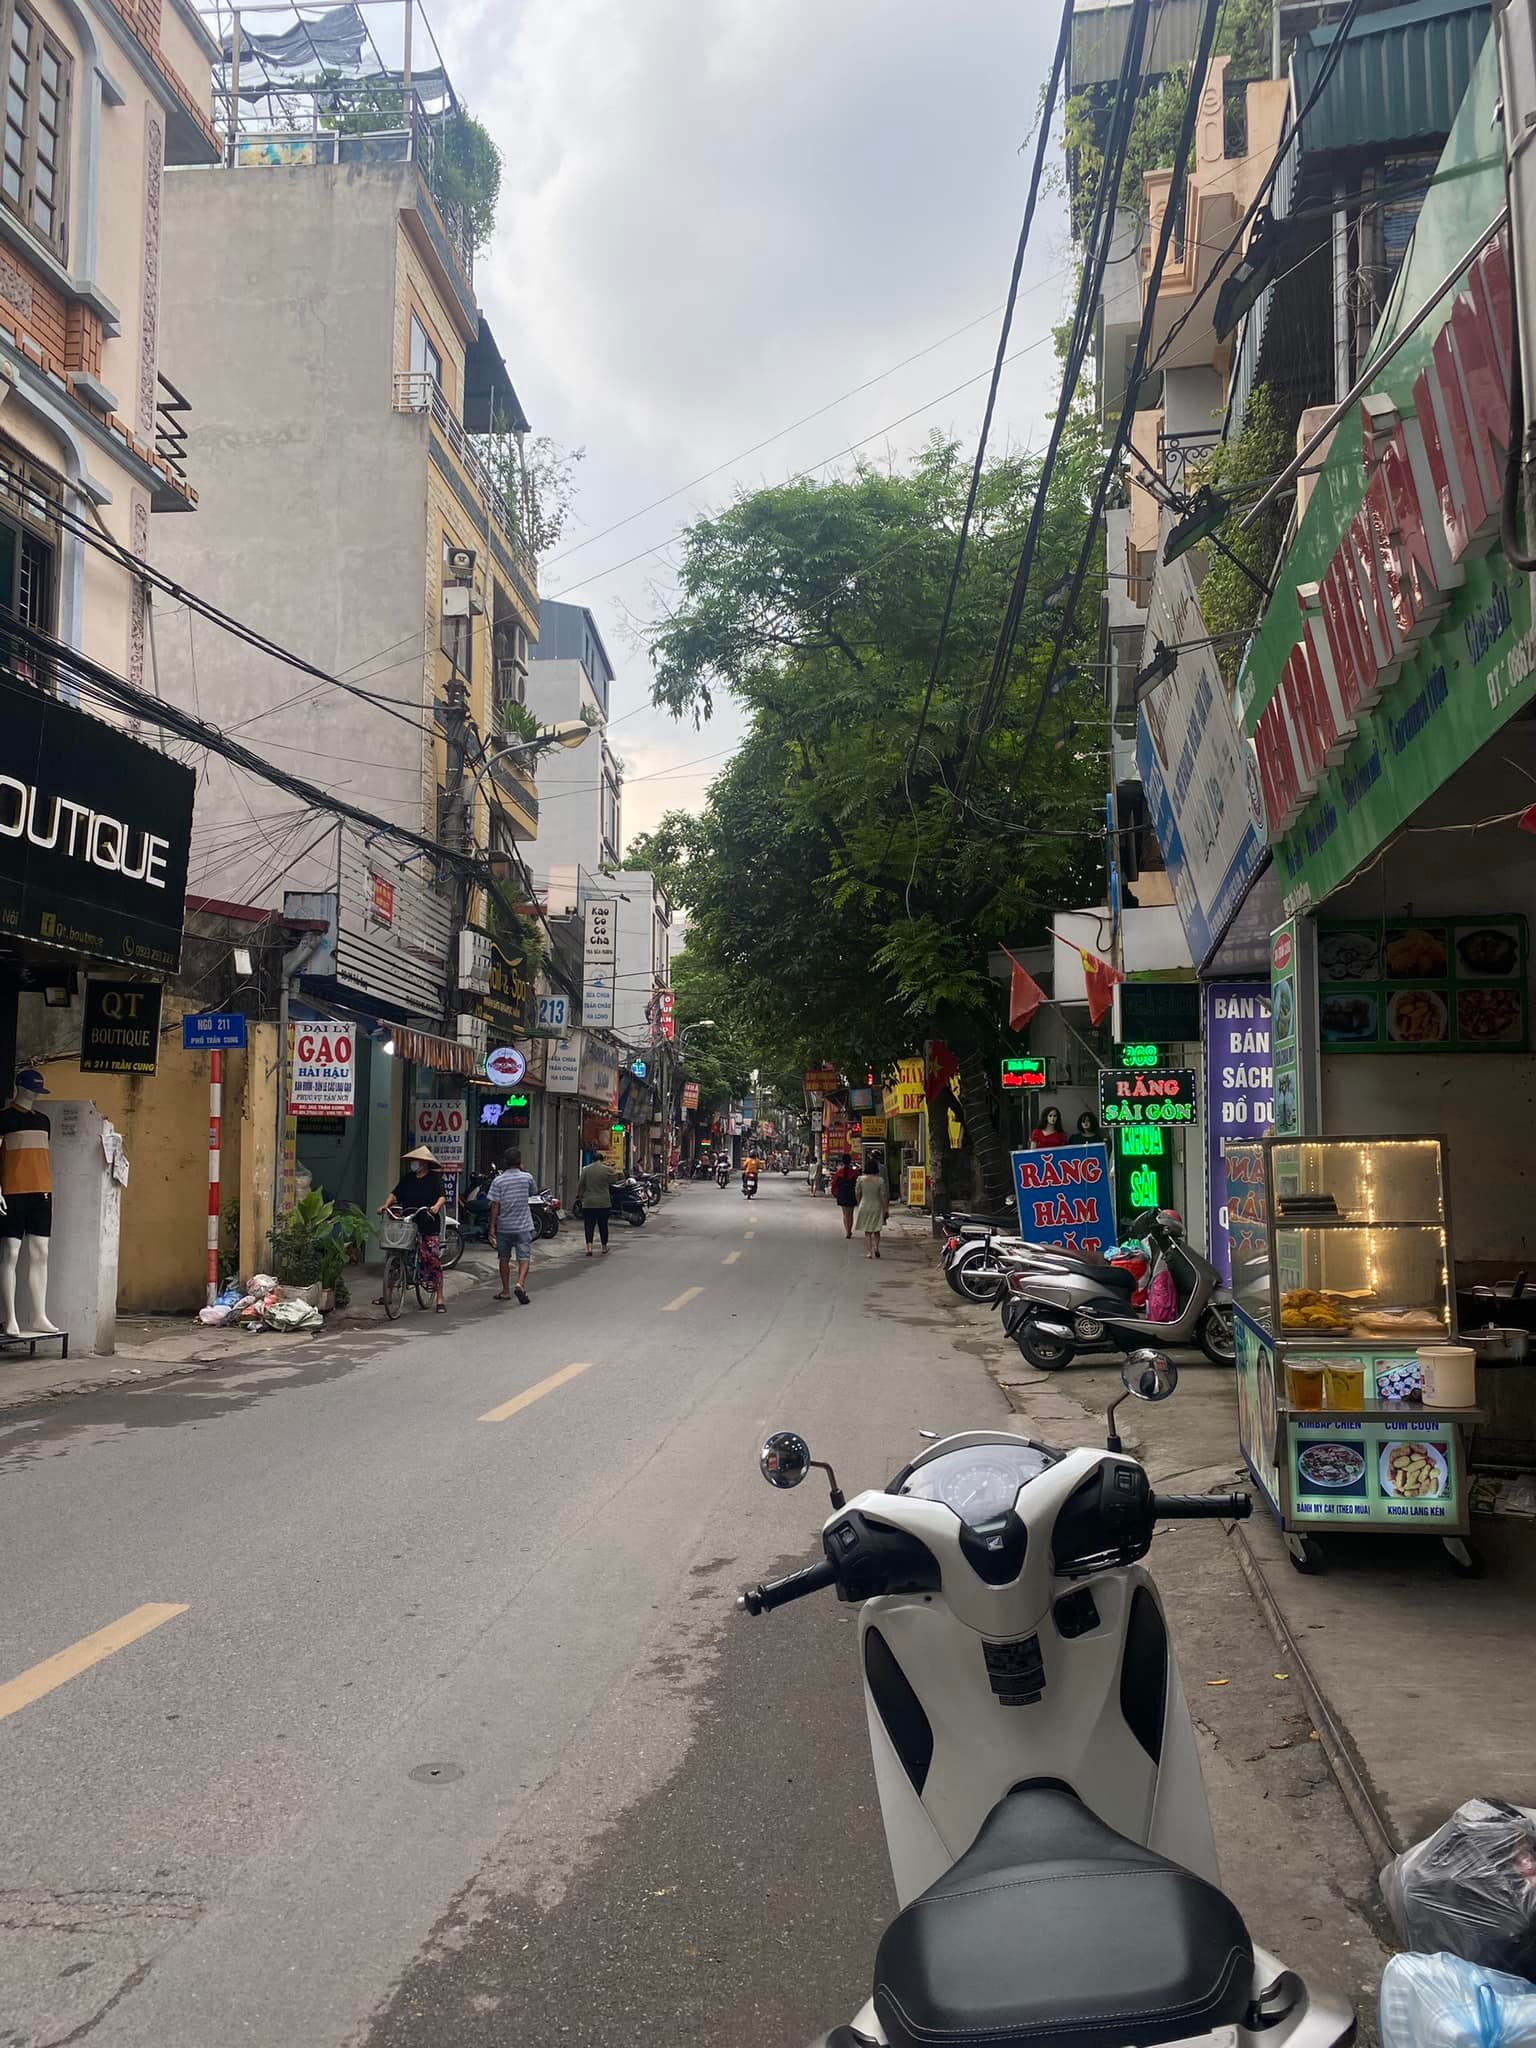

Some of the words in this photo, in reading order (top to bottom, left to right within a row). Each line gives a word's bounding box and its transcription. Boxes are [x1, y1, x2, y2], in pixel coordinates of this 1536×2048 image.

[1413, 225, 1511, 563] LIN
[592, 907, 609, 916] Kao
[593, 916, 606, 925] Co
[590, 936, 609, 945] Cha
[593, 926, 606, 935] Co
[102, 991, 144, 1019] QT
[540, 999, 565, 1025] 213
[1215, 990, 1254, 1019] BÁN
[217, 1019, 230, 1031] 211
[302, 1024, 329, 1034] ĐẠI
[333, 1022, 351, 1033] LÝ
[91, 1028, 150, 1047] BOUTIQUE
[223, 1036, 239, 1044] CUNG
[1230, 1028, 1270, 1054] BÁN
[298, 1035, 352, 1068] GẠO
[1122, 1045, 1158, 1067] 368
[93, 1060, 109, 1070] 211
[111, 1058, 132, 1071] TRẦN
[132, 1061, 155, 1072] CUNG
[298, 1066, 320, 1077] HẢI
[323, 1066, 349, 1079] HẬU
[1222, 1063, 1273, 1089] SÁCH
[1116, 1075, 1181, 1097] RĂNG
[1105, 1100, 1143, 1121] SÀI
[1145, 1098, 1192, 1120] GÒN
[1222, 1095, 1248, 1123] ĐỒ
[1254, 1097, 1275, 1123] DÙ
[418, 1110, 462, 1134] GẠO
[1019, 1153, 1103, 1189] RĂNG
[1130, 1163, 1159, 1208] SÀI
[1033, 1193, 1099, 1228] HÀM
[1296, 1503, 1313, 1513] BÁNH
[1323, 1505, 1336, 1515] CAY
[1337, 1504, 1354, 1515] (THEO
[1388, 1506, 1409, 1516] KHOAI
[1410, 1506, 1428, 1517] LANG
